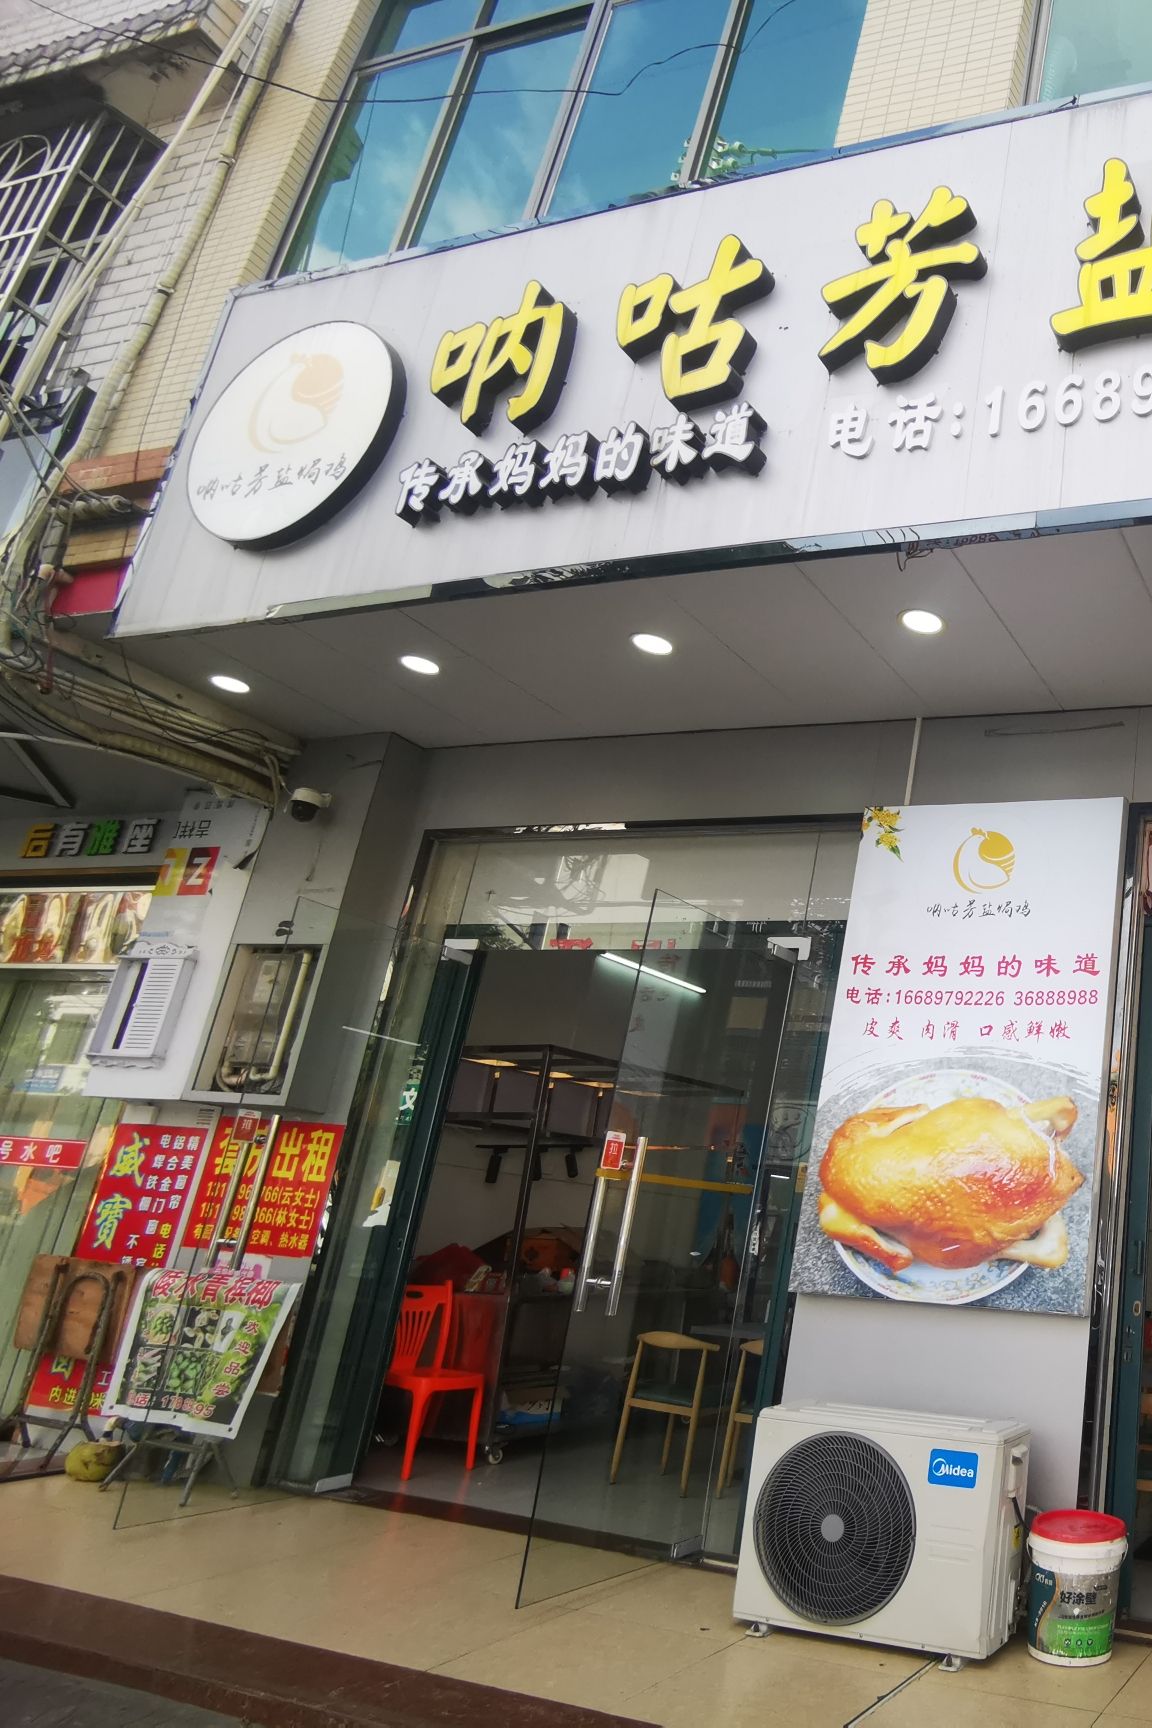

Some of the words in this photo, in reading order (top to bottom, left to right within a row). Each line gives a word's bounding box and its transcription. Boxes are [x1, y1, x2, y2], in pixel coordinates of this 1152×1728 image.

[395, 402, 760, 516] 传承妈妈的味道
[851, 953, 1100, 978] 传承妈妈的味道
[846, 986, 1005, 1007] 电话:16689792226
[1013, 988, 1099, 1007] 36888988
[862, 1016, 904, 1041] 皮爽
[920, 1019, 960, 1042] 肉滑
[979, 1018, 1072, 1043] 口感鲜嫩
[932, 1457, 975, 1480] Midea
